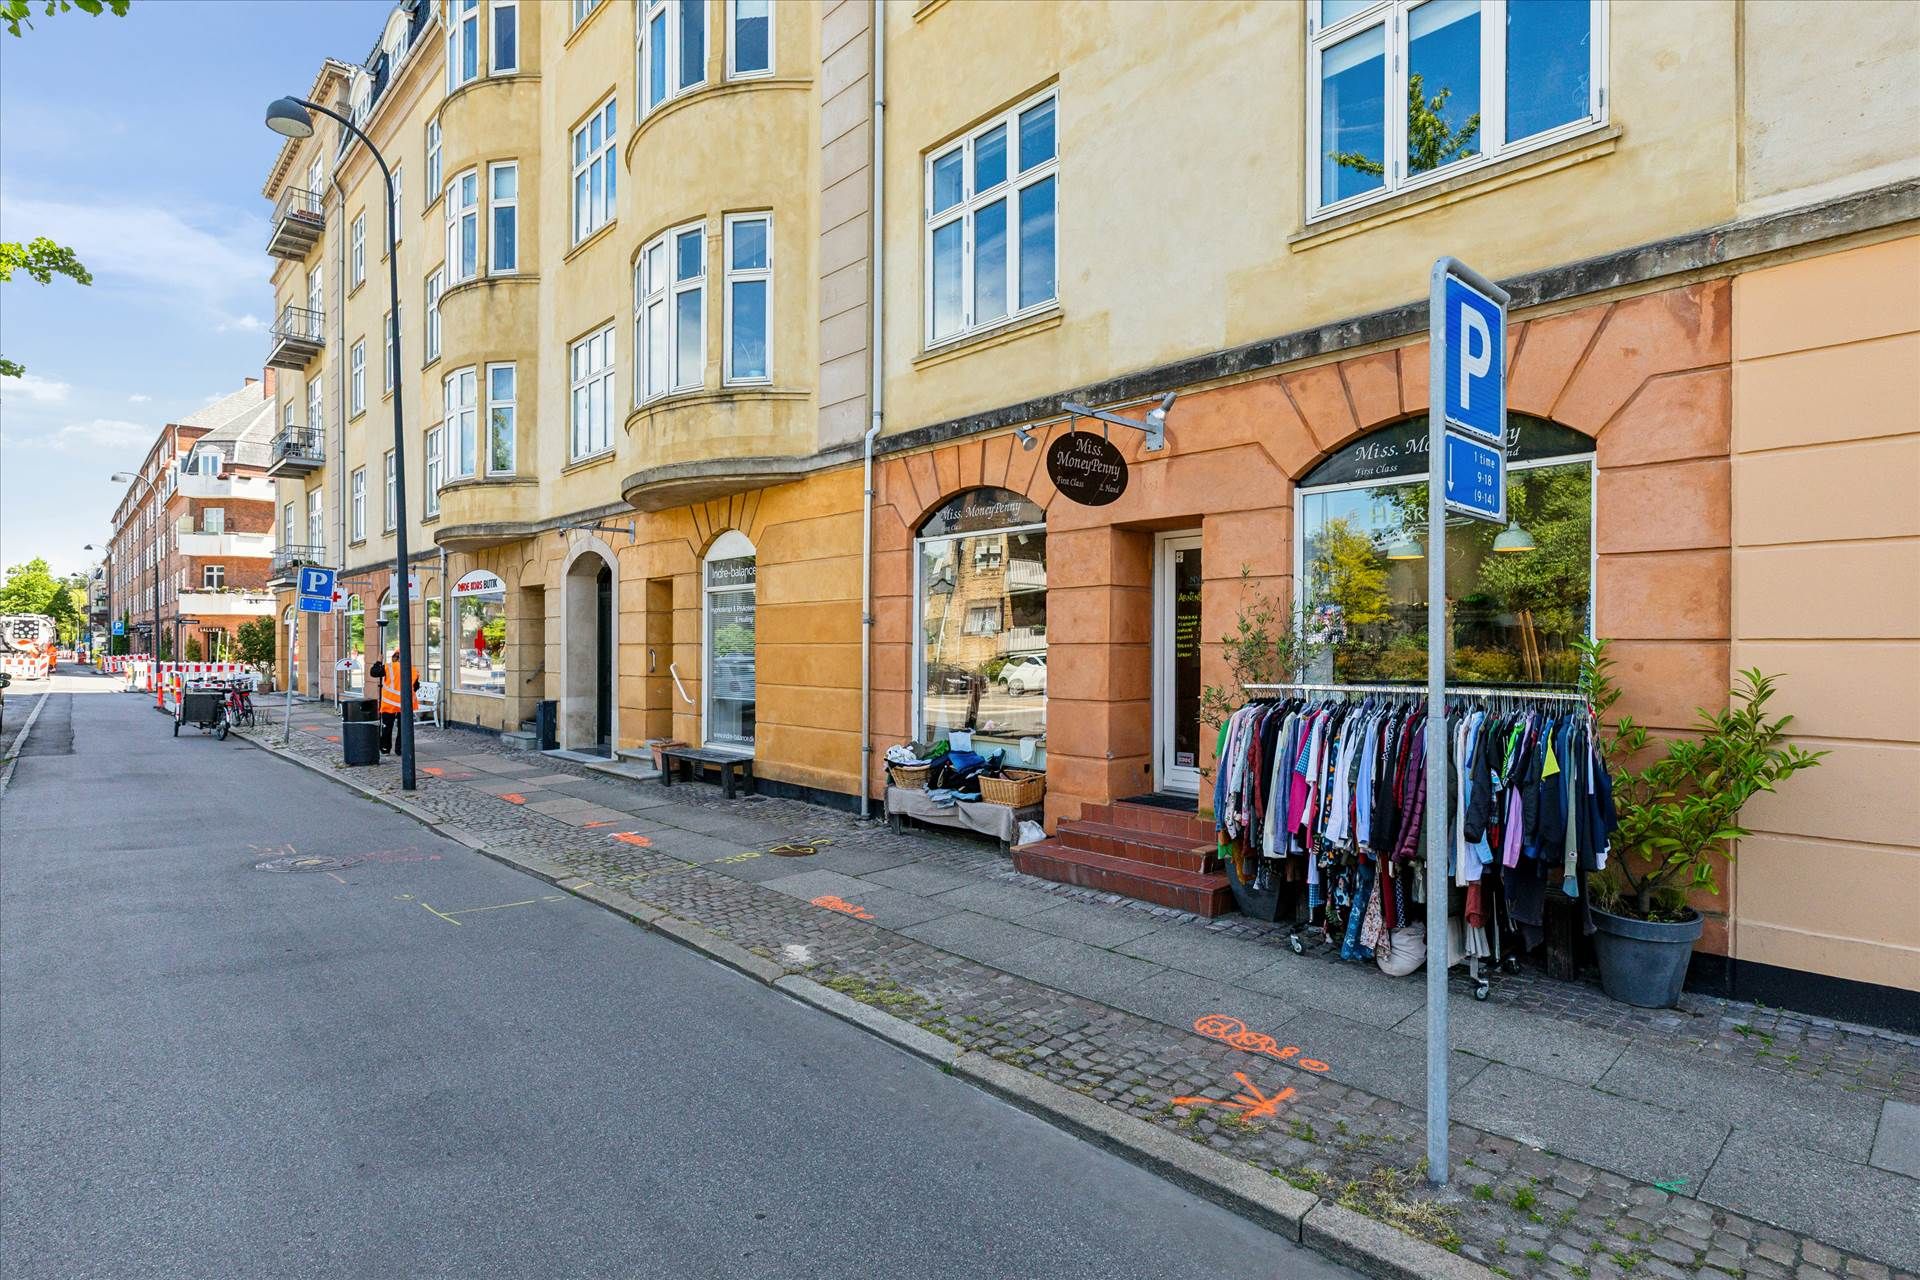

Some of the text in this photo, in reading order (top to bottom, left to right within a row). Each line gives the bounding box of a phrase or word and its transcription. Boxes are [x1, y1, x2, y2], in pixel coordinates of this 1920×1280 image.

[1460, 301, 1492, 411] P
[1076, 438, 1104, 457] Miss.
[1355, 442, 1399, 462] Miss.
[1056, 450, 1121, 482] MoneyPenny
[1474, 450, 1496, 469] 1 time
[1355, 466, 1374, 478] First
[1376, 464, 1399, 474] Class
[1477, 471, 1493, 487] 9-18
[1474, 489, 1495, 506] (9-14)
[940, 502, 1022, 521] Miss. MoneyPenny
[306, 571, 328, 593] P
[114, 622, 122, 631] P
